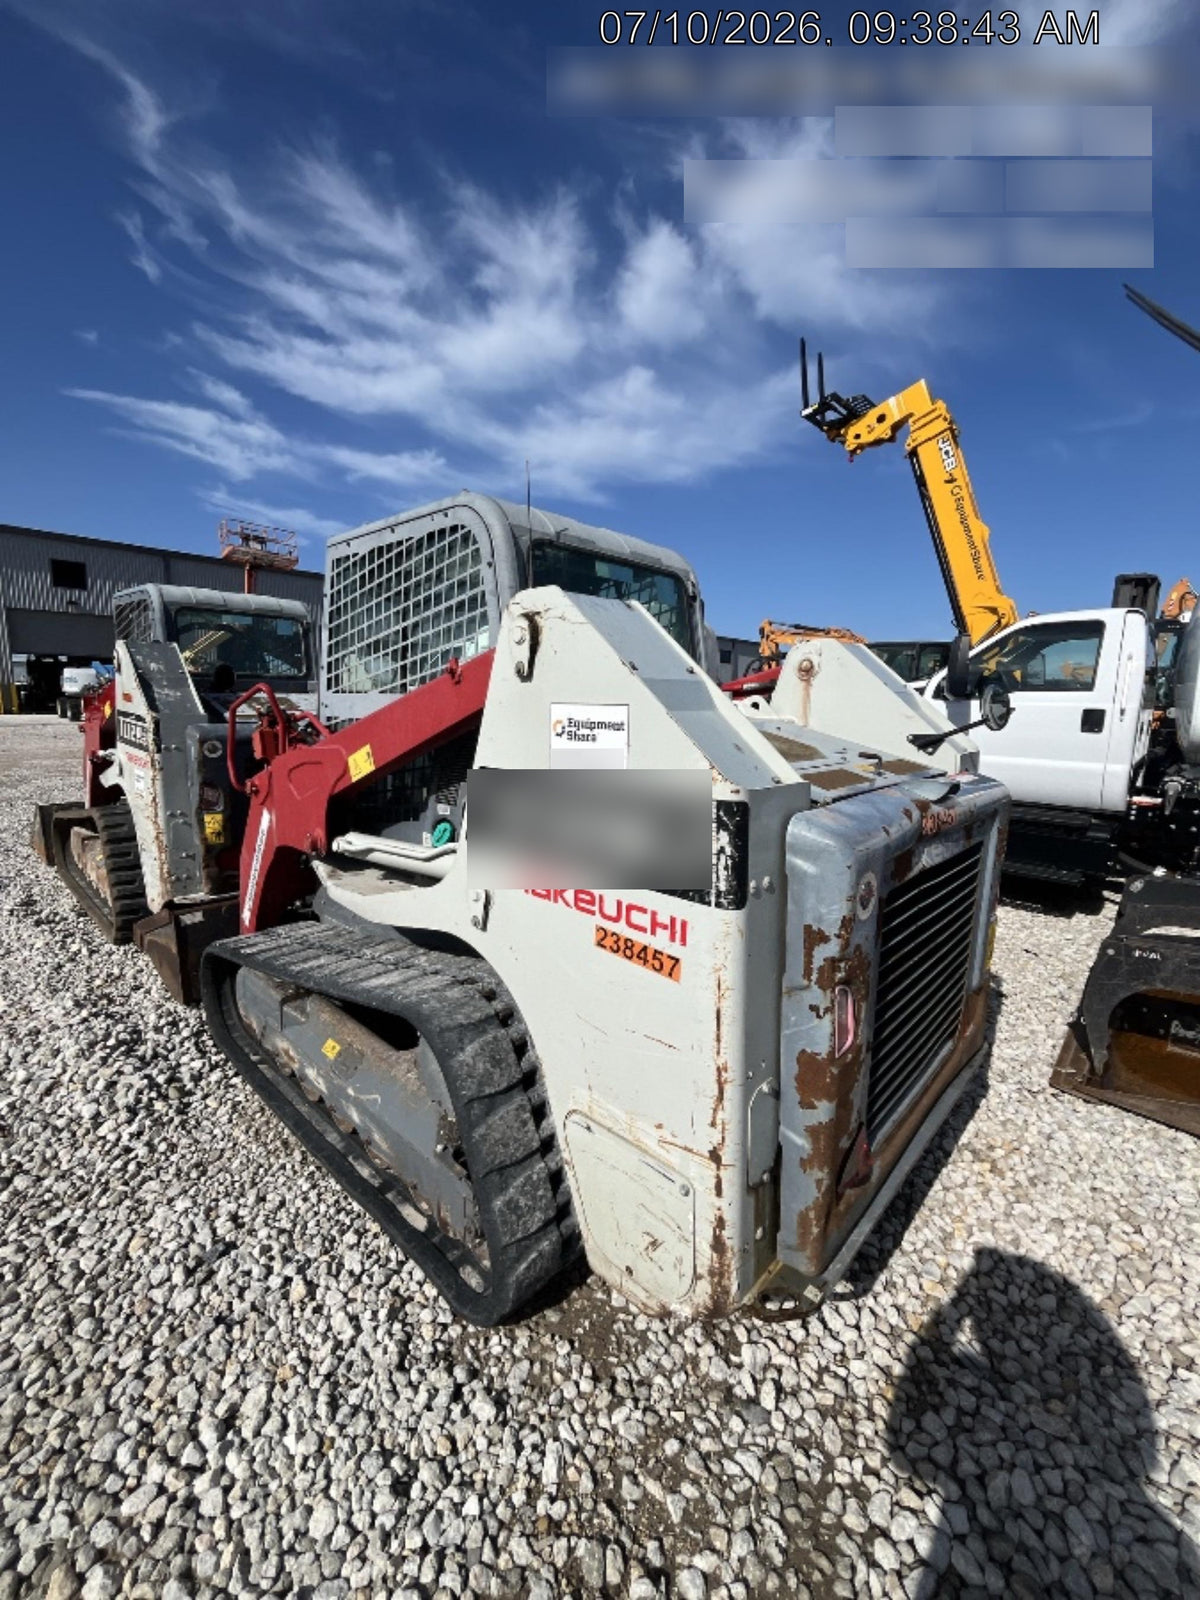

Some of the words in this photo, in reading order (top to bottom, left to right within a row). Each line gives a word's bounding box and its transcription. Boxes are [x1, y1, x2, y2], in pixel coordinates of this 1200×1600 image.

[939, 436, 957, 471] JCB
[566, 717, 626, 732] Equipment
[566, 730, 597, 743] Share
[596, 926, 681, 978] 238457
